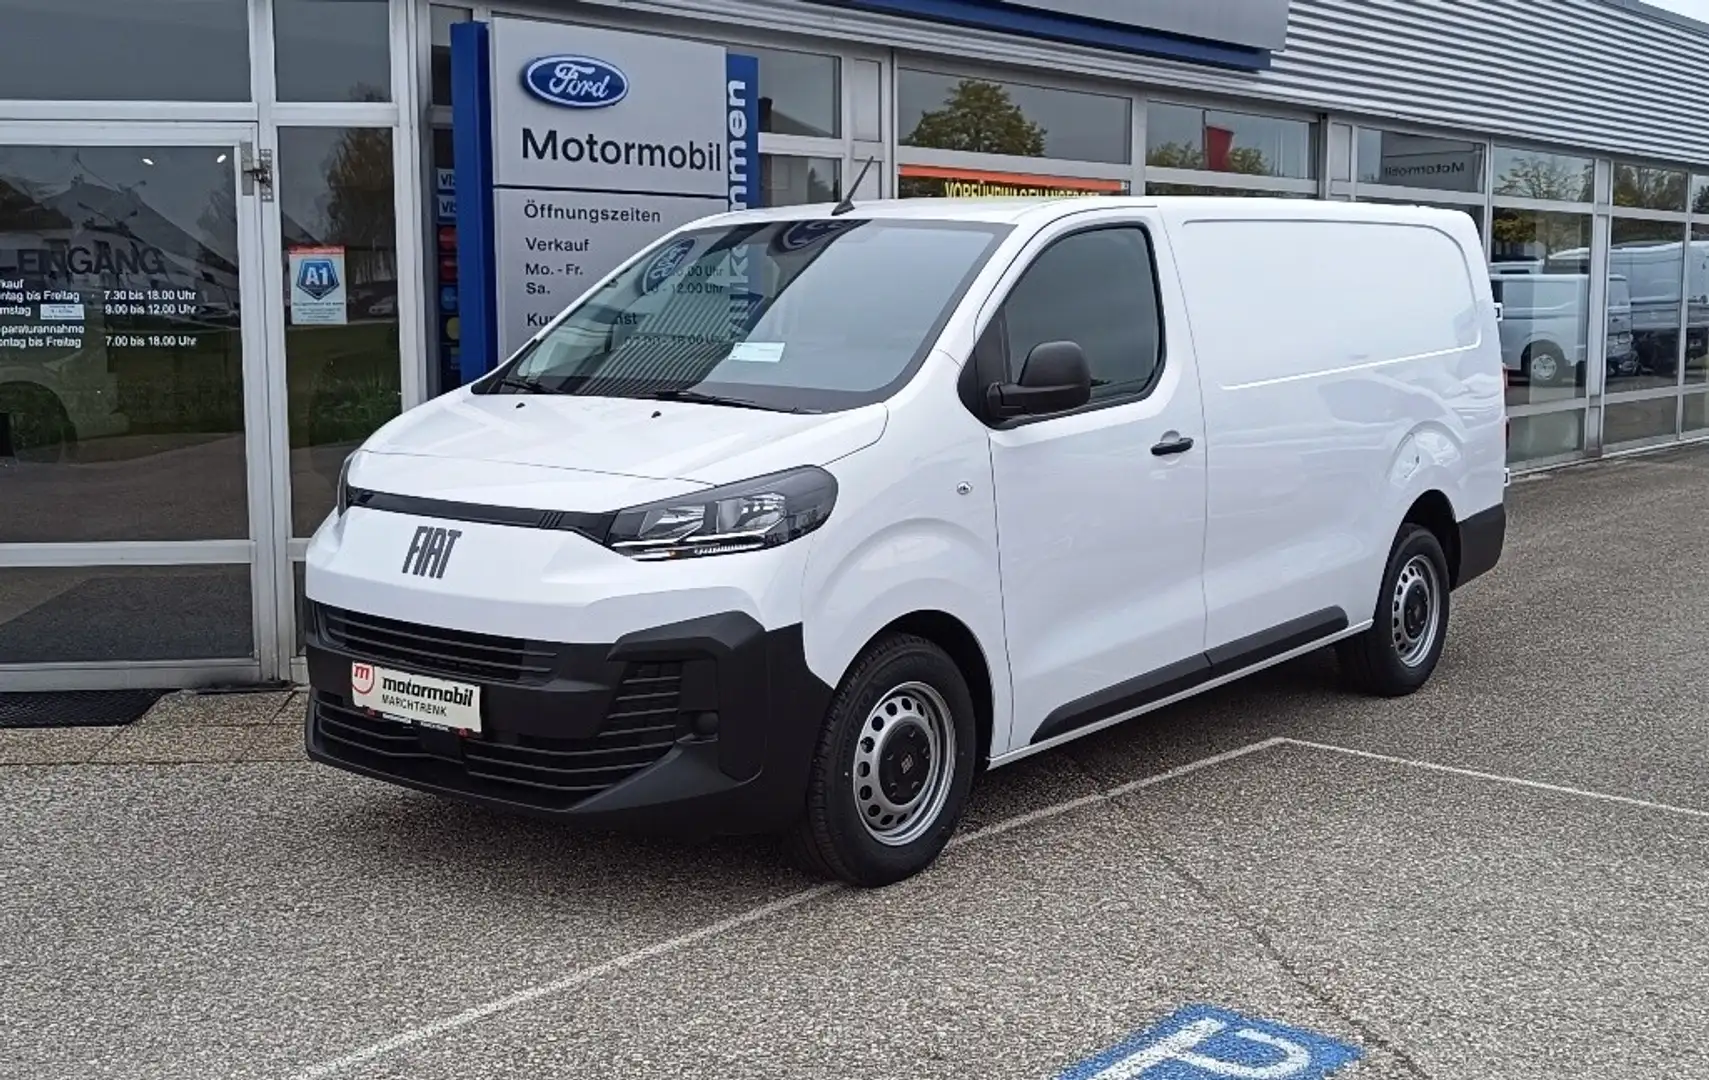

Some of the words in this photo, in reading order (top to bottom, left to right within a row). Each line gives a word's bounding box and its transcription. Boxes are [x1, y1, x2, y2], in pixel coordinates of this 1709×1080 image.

[549, 63, 609, 98] Ford
[521, 128, 722, 171] Motormobil
[524, 199, 661, 223] Öffnungszeiten
[525, 237, 590, 252] Verkauf
[17, 247, 165, 275] EINGANG
[305, 266, 330, 285] A1
[0, 290, 24, 303] ntag
[27, 291, 41, 301] bis
[44, 290, 80, 303] Freitag
[104, 290, 126, 300] 7.30
[129, 290, 144, 300] bis
[147, 290, 175, 300] 18.00
[177, 290, 196, 300] Uhr
[525, 282, 550, 294] Sa.
[705, 282, 724, 294] Uhr
[0, 305, 31, 316] mstag
[105, 304, 128, 314] 9.00
[131, 304, 145, 314] bis
[148, 304, 176, 315] 12.00
[178, 304, 196, 314] Uhr
[0, 324, 84, 337] paraturannahme
[28, 336, 44, 347] bis
[46, 336, 82, 349] Freitag
[105, 336, 128, 347] 7.00
[131, 336, 145, 347] bis
[148, 336, 176, 347] 18.00
[178, 336, 197, 347] Uhr
[401, 525, 463, 579] FIAT
[382, 677, 474, 707] motormobil
[382, 693, 448, 717] MARCHTRENK
